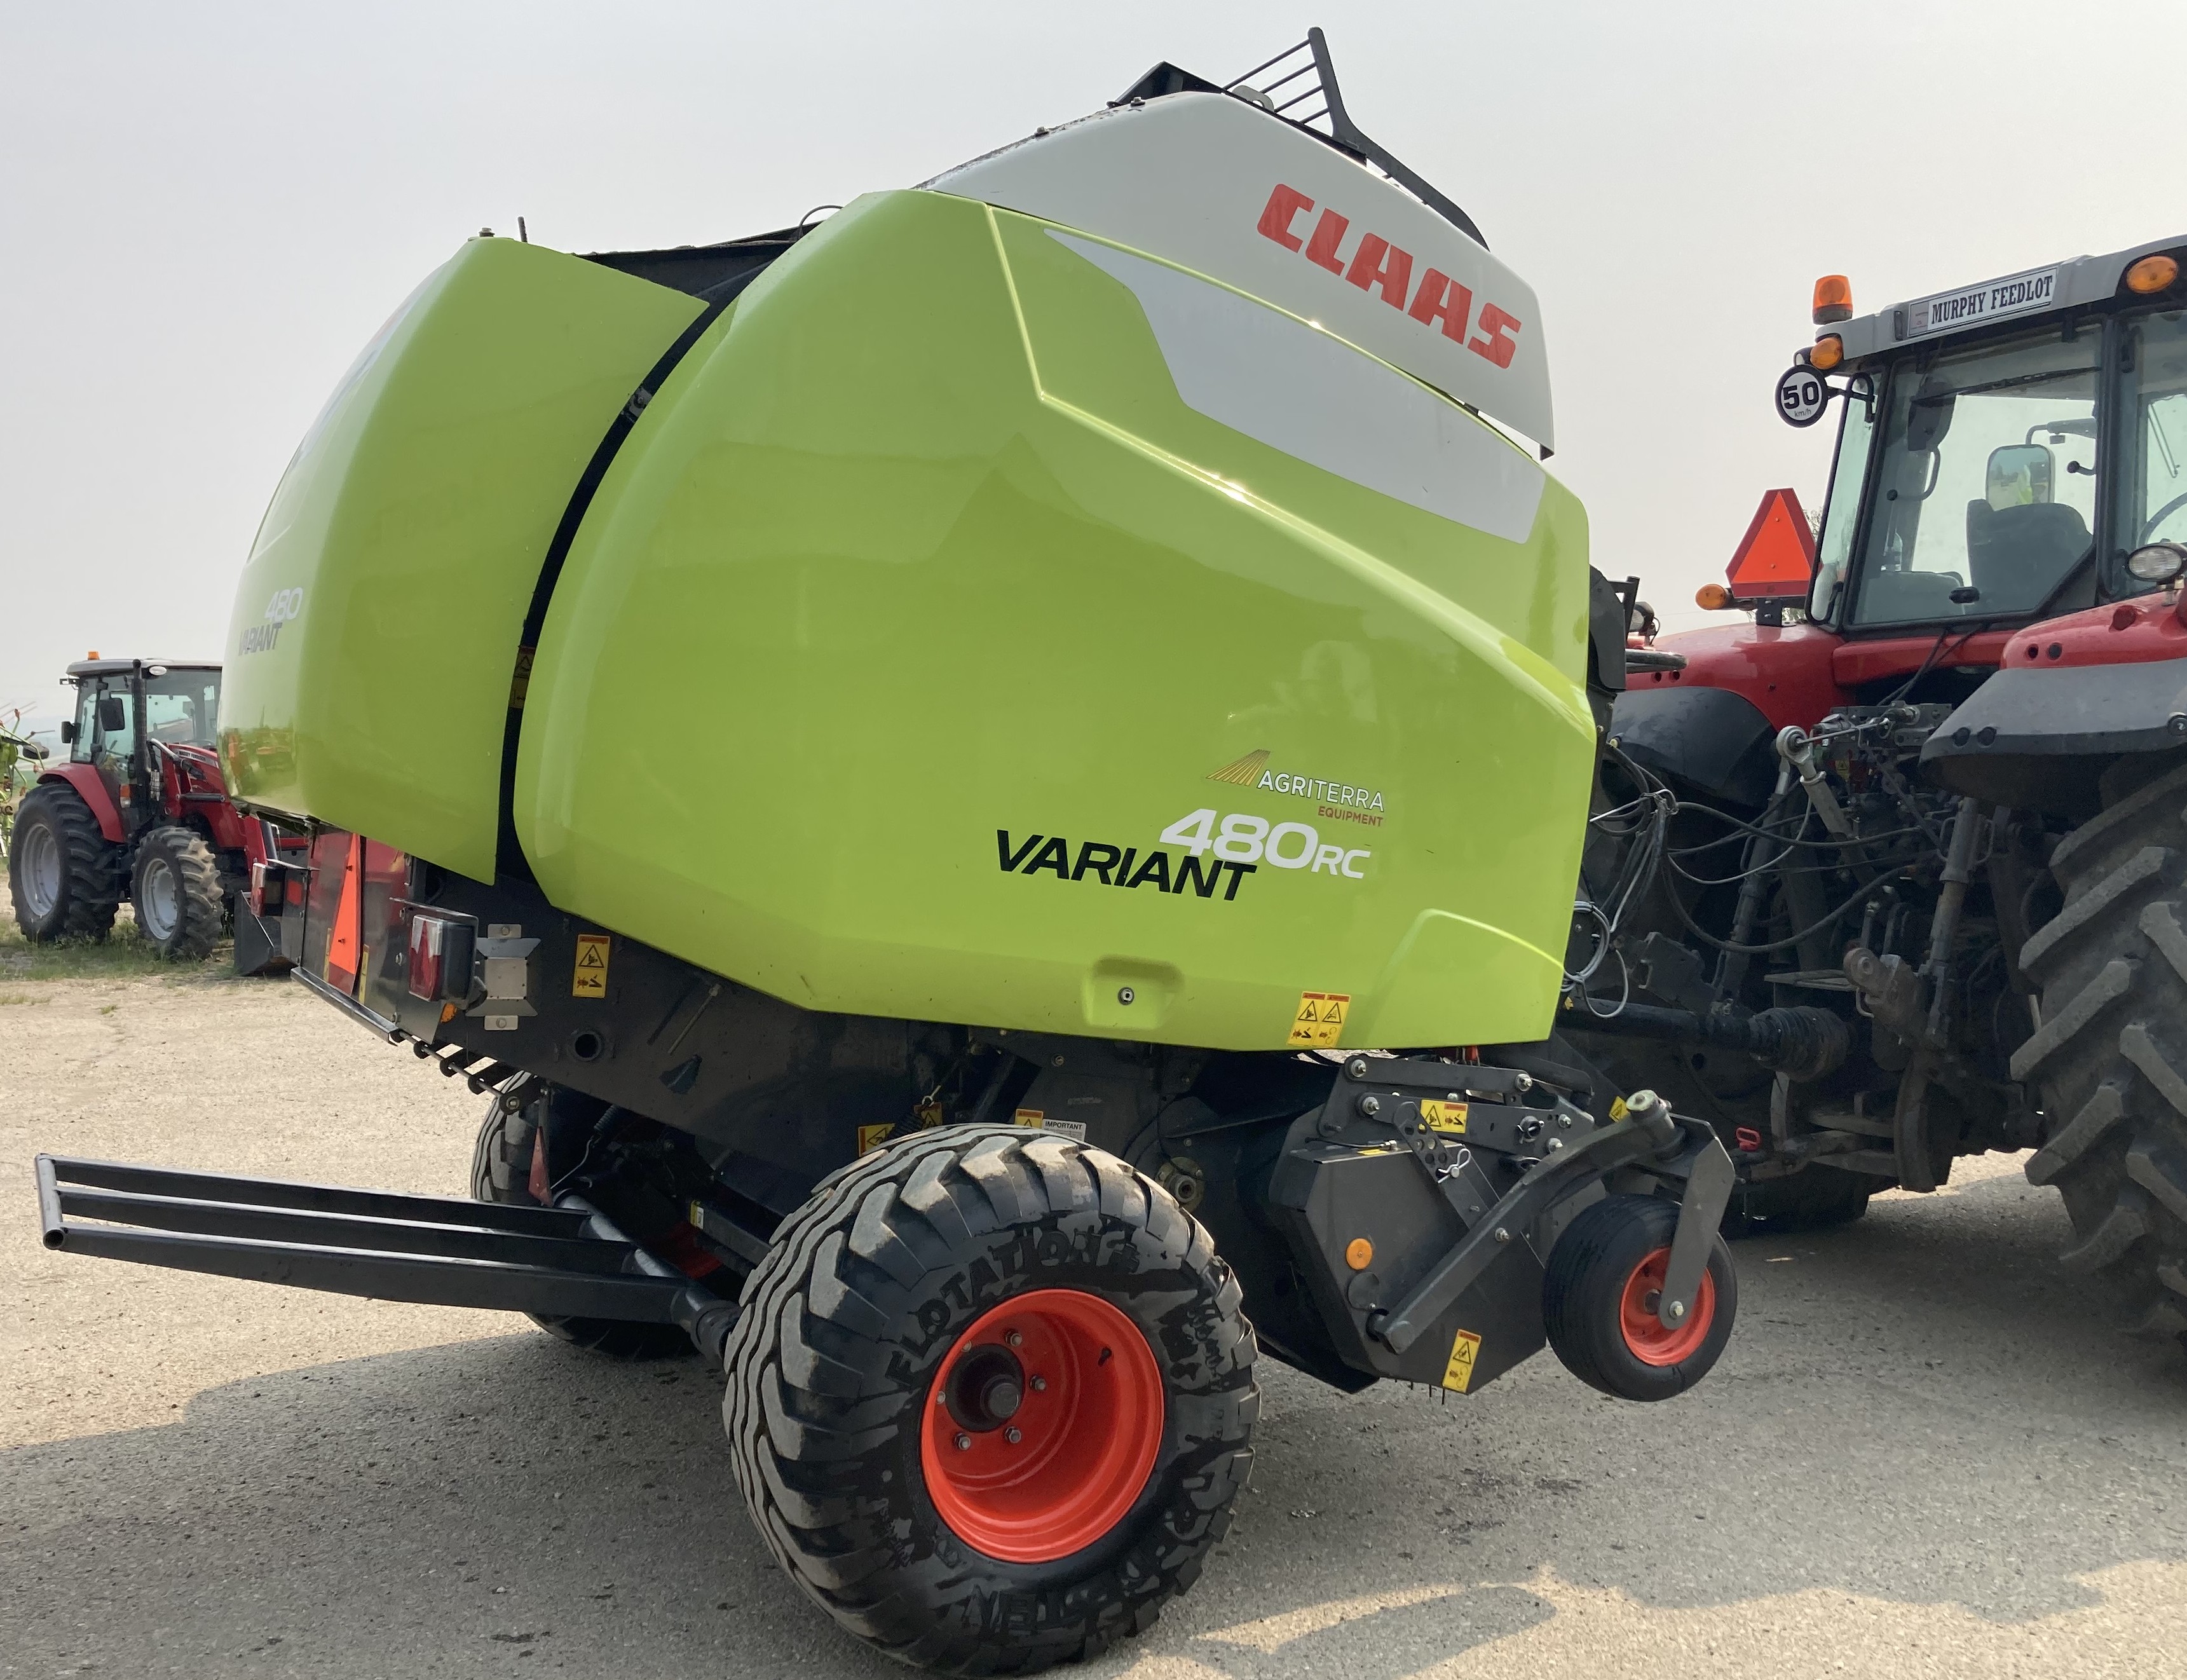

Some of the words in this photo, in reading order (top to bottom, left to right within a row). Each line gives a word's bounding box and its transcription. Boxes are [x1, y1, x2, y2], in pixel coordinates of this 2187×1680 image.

[1257, 184, 1522, 369] CLAAS
[1932, 292, 1986, 324] MURPHY
[1991, 275, 2052, 310] FEEDLOT
[1783, 381, 1819, 409] 50
[1794, 408, 1811, 417] km/h
[264, 587, 303, 622] 480
[238, 622, 282, 656] VARIANT
[1257, 770, 1384, 812] AGRITERRA
[1318, 805, 1384, 826] EQUIPMENT
[997, 829, 1257, 901] VARIANT
[1046, 1121, 1082, 1130] IMPORTANT
